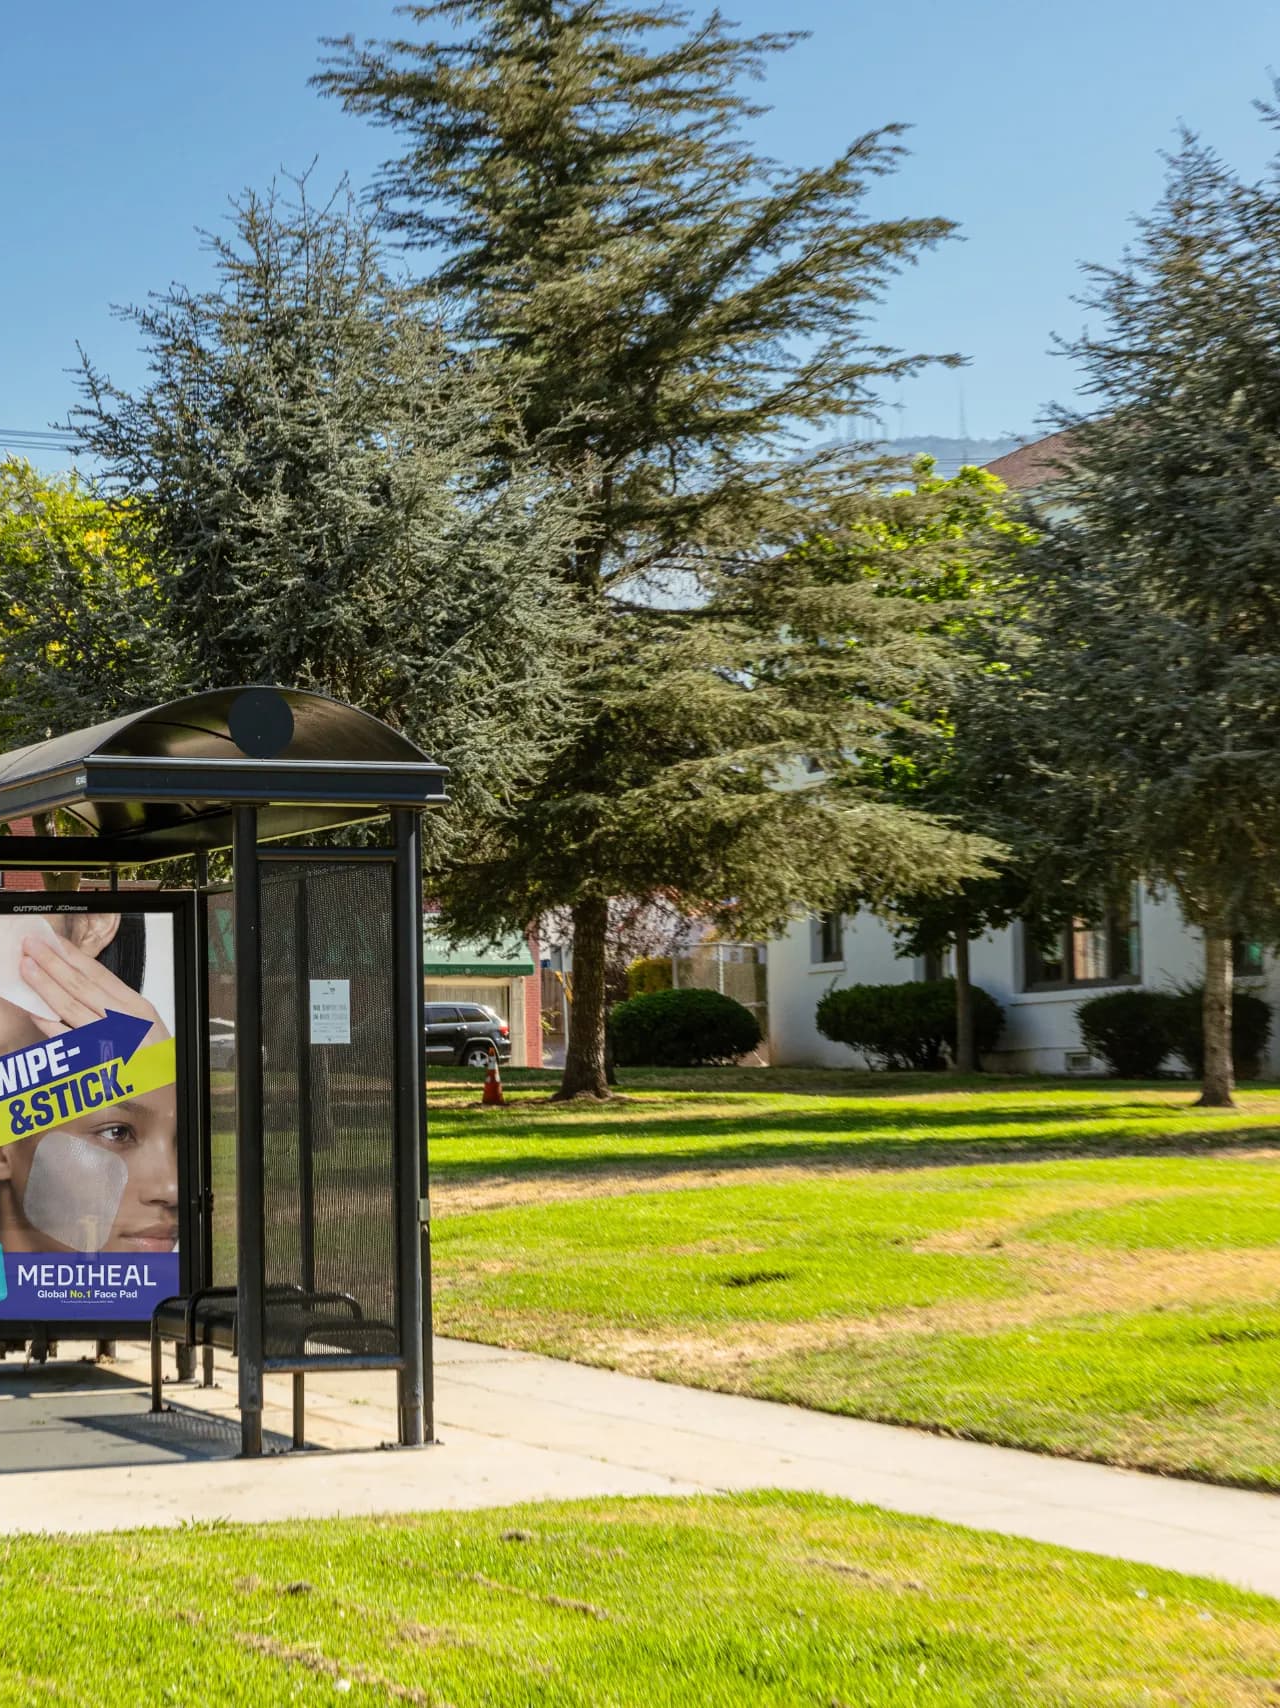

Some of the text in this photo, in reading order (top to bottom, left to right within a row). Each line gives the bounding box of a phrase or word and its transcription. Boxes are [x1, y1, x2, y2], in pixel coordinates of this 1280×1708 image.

[9, 1063, 134, 1135] &STICK.
[18, 1265, 157, 1286] MEDIHEAL
[37, 1290, 138, 1298] Global No.1 Face Pad
